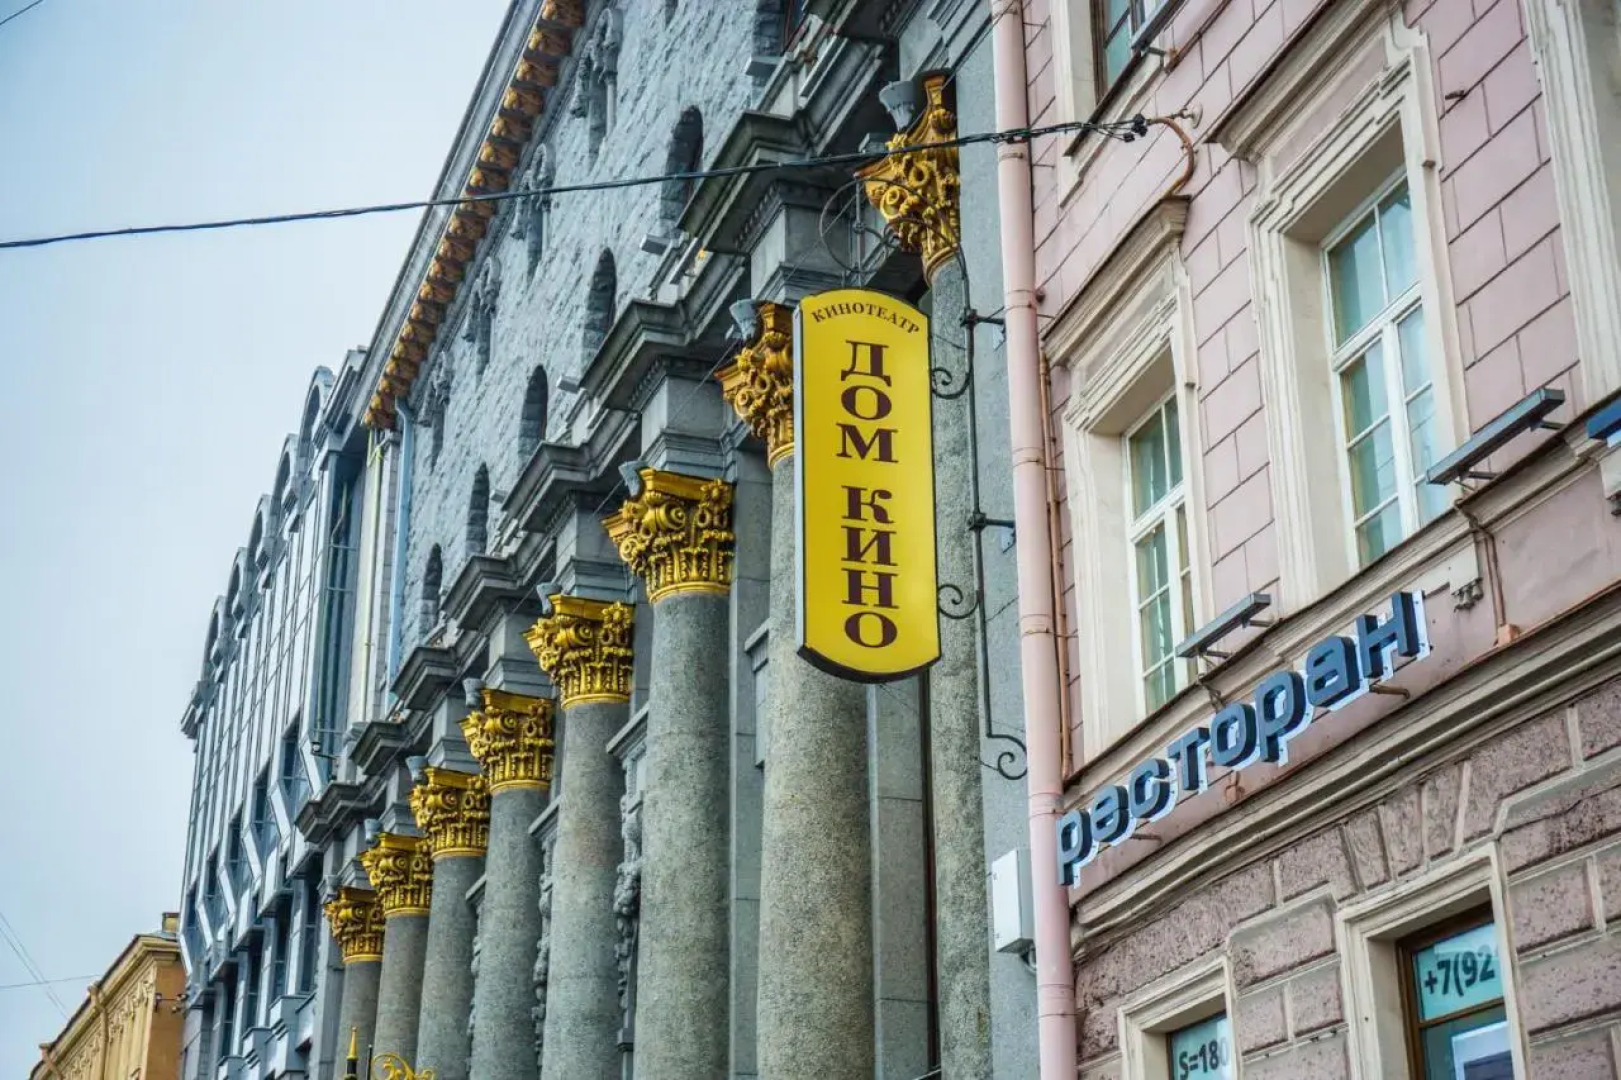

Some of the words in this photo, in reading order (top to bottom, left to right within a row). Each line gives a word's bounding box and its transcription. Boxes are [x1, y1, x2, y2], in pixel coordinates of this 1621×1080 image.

[811, 303, 920, 334] КИНОТЕАТР
[835, 340, 899, 463] ДОМ
[840, 485, 899, 648] КИНО
[1056, 590, 1431, 888] ресторан
